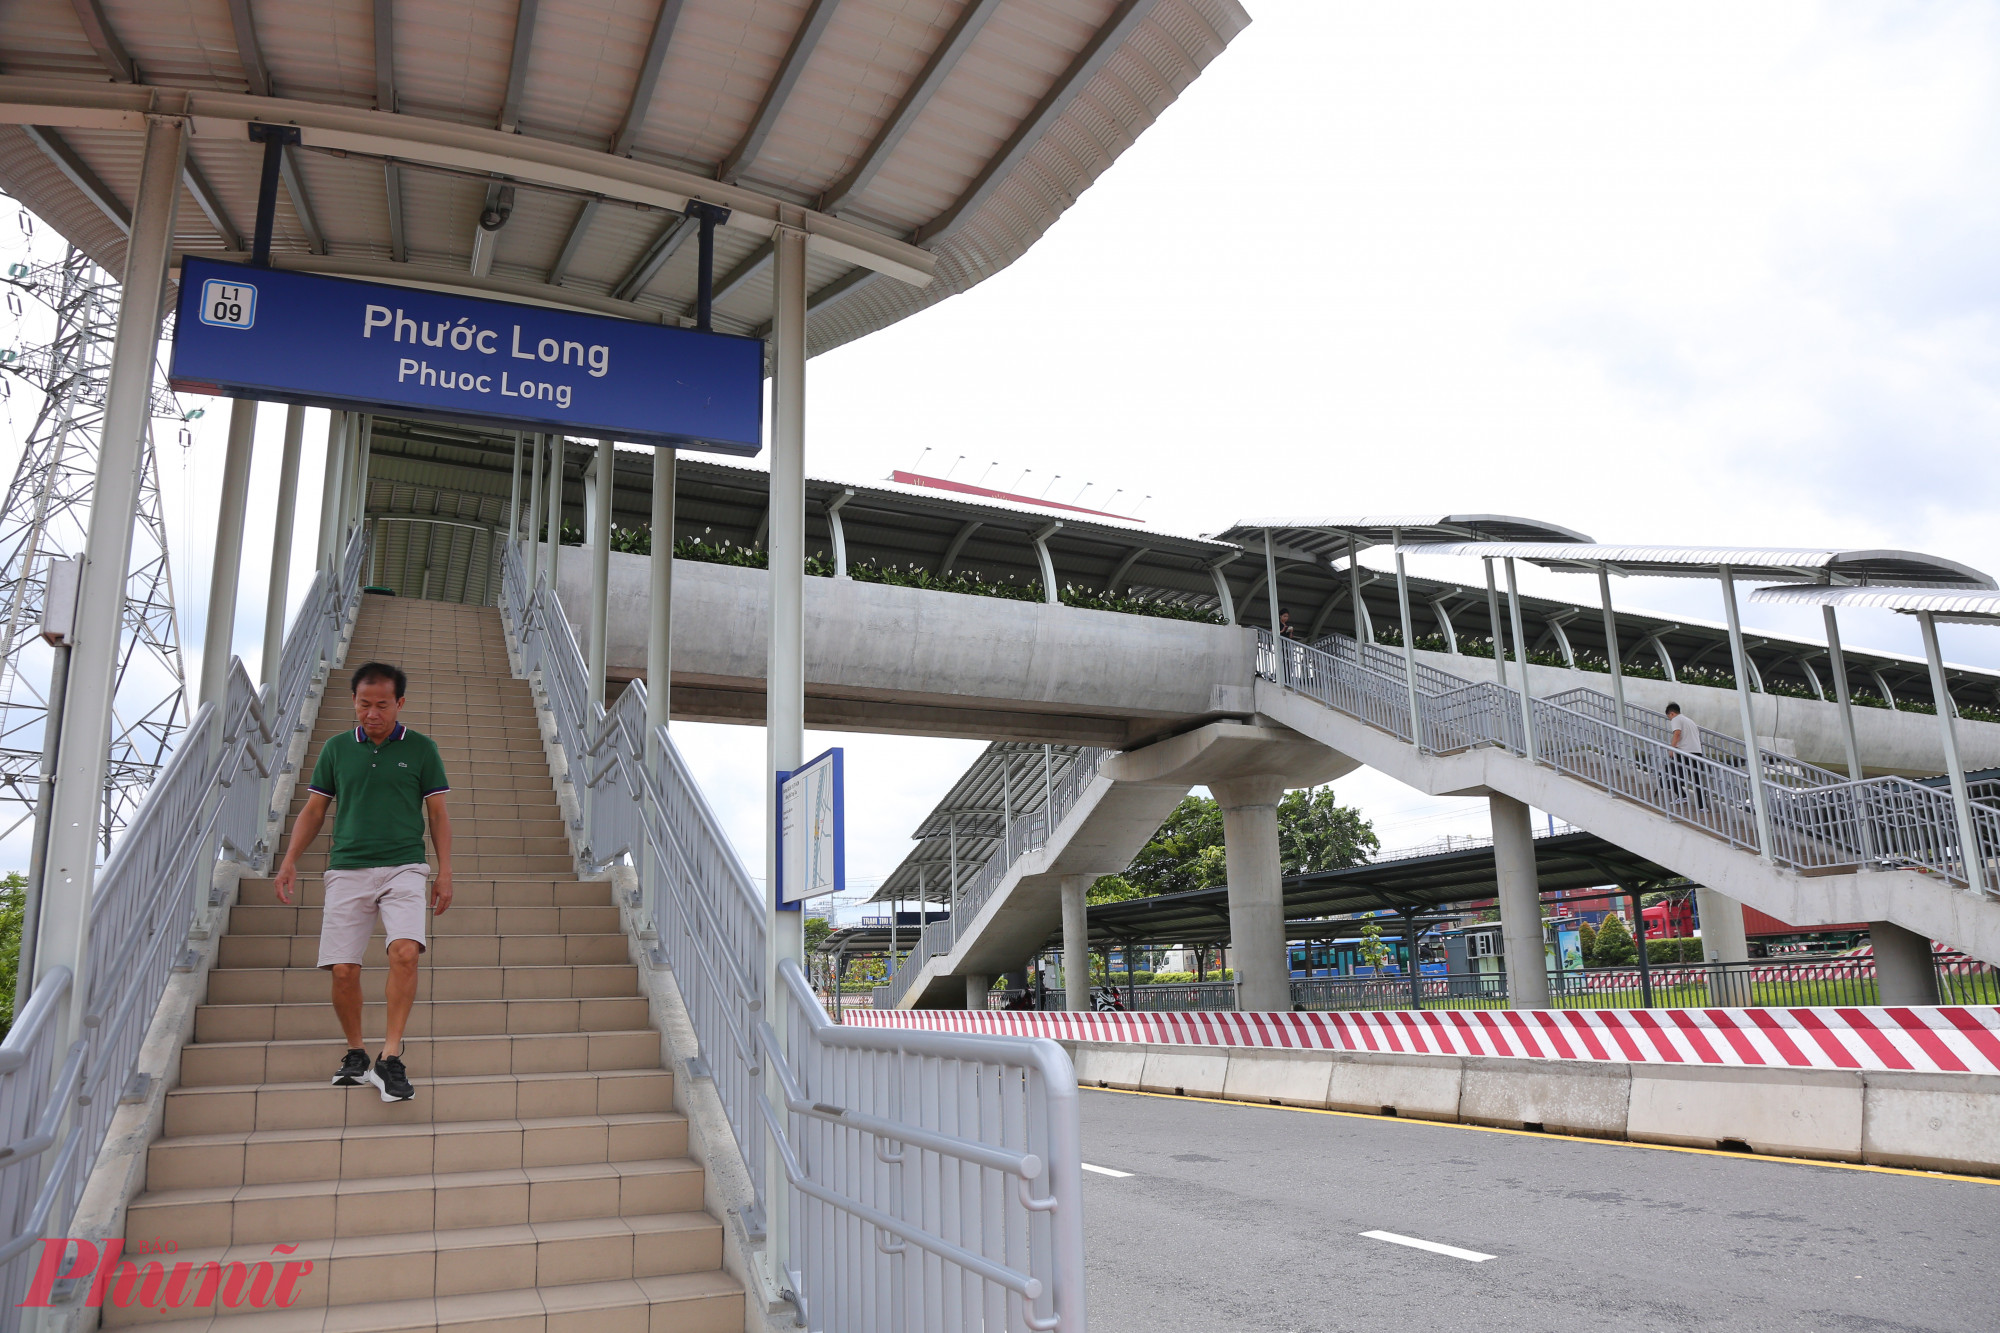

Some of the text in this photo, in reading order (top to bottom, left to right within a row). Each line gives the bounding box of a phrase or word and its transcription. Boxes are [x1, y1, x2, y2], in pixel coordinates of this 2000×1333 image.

[213, 301, 242, 322] 09
[221, 286, 239, 301] L1
[363, 304, 609, 378] Phước Long
[398, 358, 572, 409] Phuoc Long
